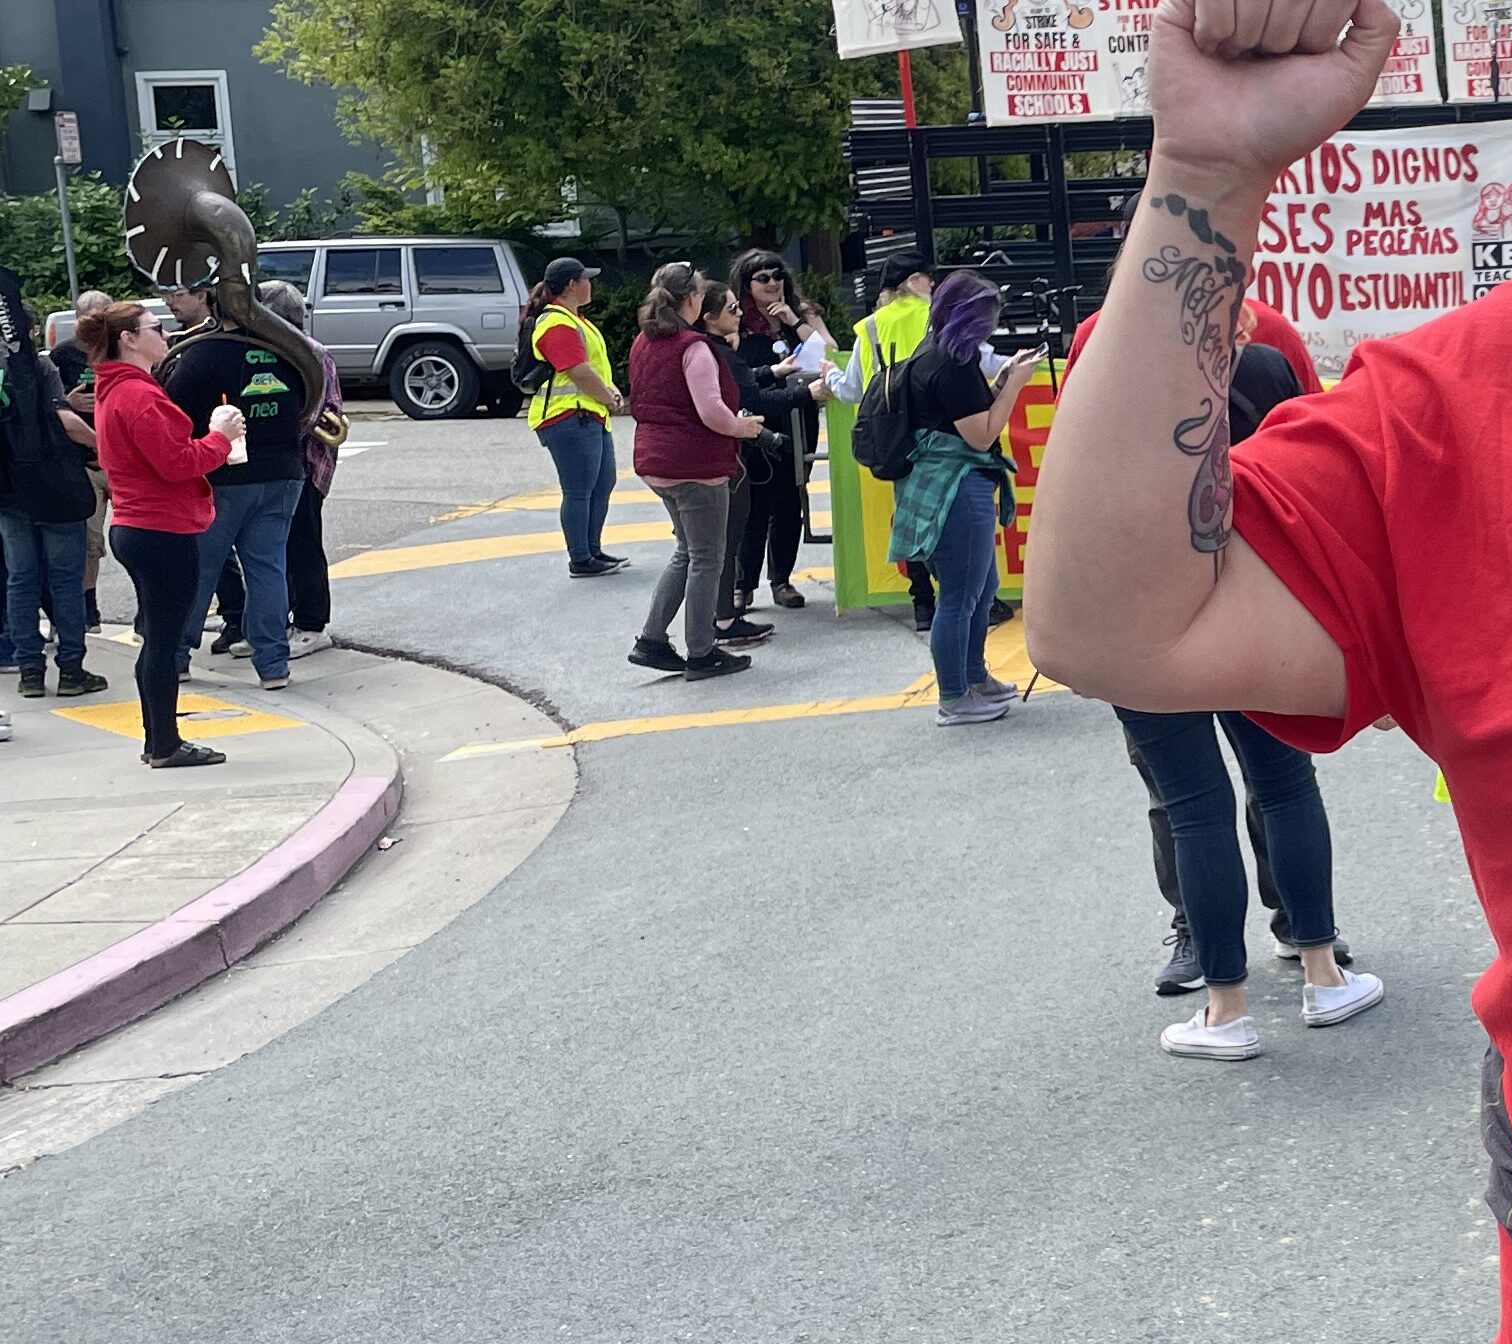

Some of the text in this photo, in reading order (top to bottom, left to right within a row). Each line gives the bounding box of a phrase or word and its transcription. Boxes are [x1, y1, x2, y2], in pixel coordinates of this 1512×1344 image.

[1005, 31, 1081, 51] FOR SAFE &
[992, 50, 1098, 73] RACIALLY JUST
[1006, 74, 1086, 92] COMMUNITY
[1013, 94, 1084, 115] SCHOOLS
[1373, 143, 1479, 185] DIGNOS
[1255, 200, 1423, 254] SES MAS
[249, 401, 279, 418] nea
